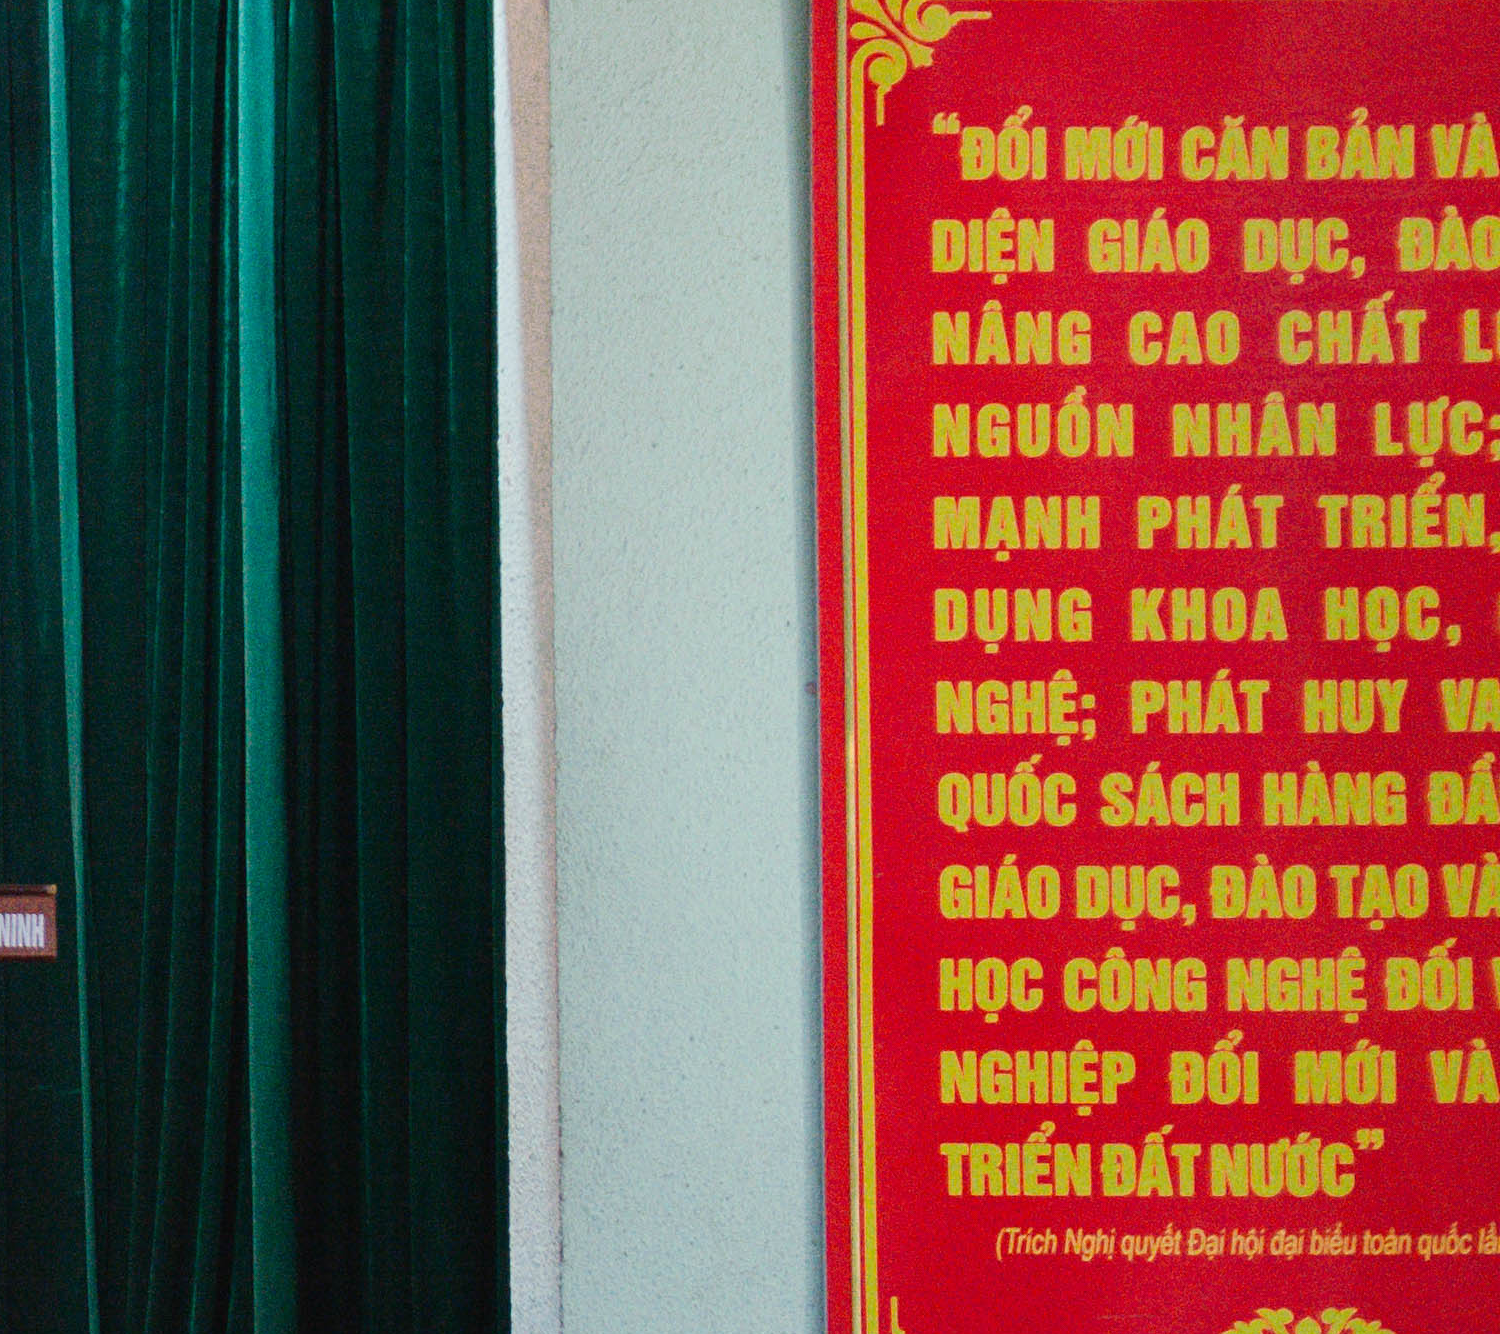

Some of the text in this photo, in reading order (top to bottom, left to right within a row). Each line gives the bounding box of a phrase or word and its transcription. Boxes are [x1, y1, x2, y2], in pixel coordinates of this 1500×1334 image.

[933, 106, 1500, 180] “ĐỔI MỚI CĂN BẢN VÀ
[933, 206, 1500, 284] DIỆN GIÁO DỤC, ĐÀO
[933, 301, 1090, 365] NÂNG
[1129, 311, 1239, 365] CAO
[1279, 292, 1426, 364] CHẤT
[934, 386, 1500, 466] NGUỒN NHÂN LỰC;
[934, 473, 1500, 561] MẠNH PHÁT TRIỂN,
[935, 587, 1460, 653] DỤNG KHOA HỌC,
[936, 670, 1500, 745] NGHỆ; PHÁT HUY VA
[939, 755, 1076, 832] QUỐC
[1101, 762, 1239, 826] SÁCH
[1264, 762, 1406, 825] HÀNG
[940, 853, 1500, 930] GIÁO DỤC, ĐÀO TẠO VÀ
[940, 958, 1042, 1022] HỌC
[1064, 948, 1206, 1011] CÔNG
[1227, 947, 1366, 1022] NGHỆ
[1385, 939, 1472, 1010] ĐỐI
[941, 1030, 1500, 1115] NGHIỆP ĐỔI MỚI VÀ
[941, 1122, 1383, 1197] TRIỂN ĐẤT NƯỚC”
[1187, 1228, 1226, 1260] Đại
[1231, 1227, 1265, 1260] hội
[1417, 1221, 1472, 1261] quốc
[1477, 1221, 1500, 1255] lầ
